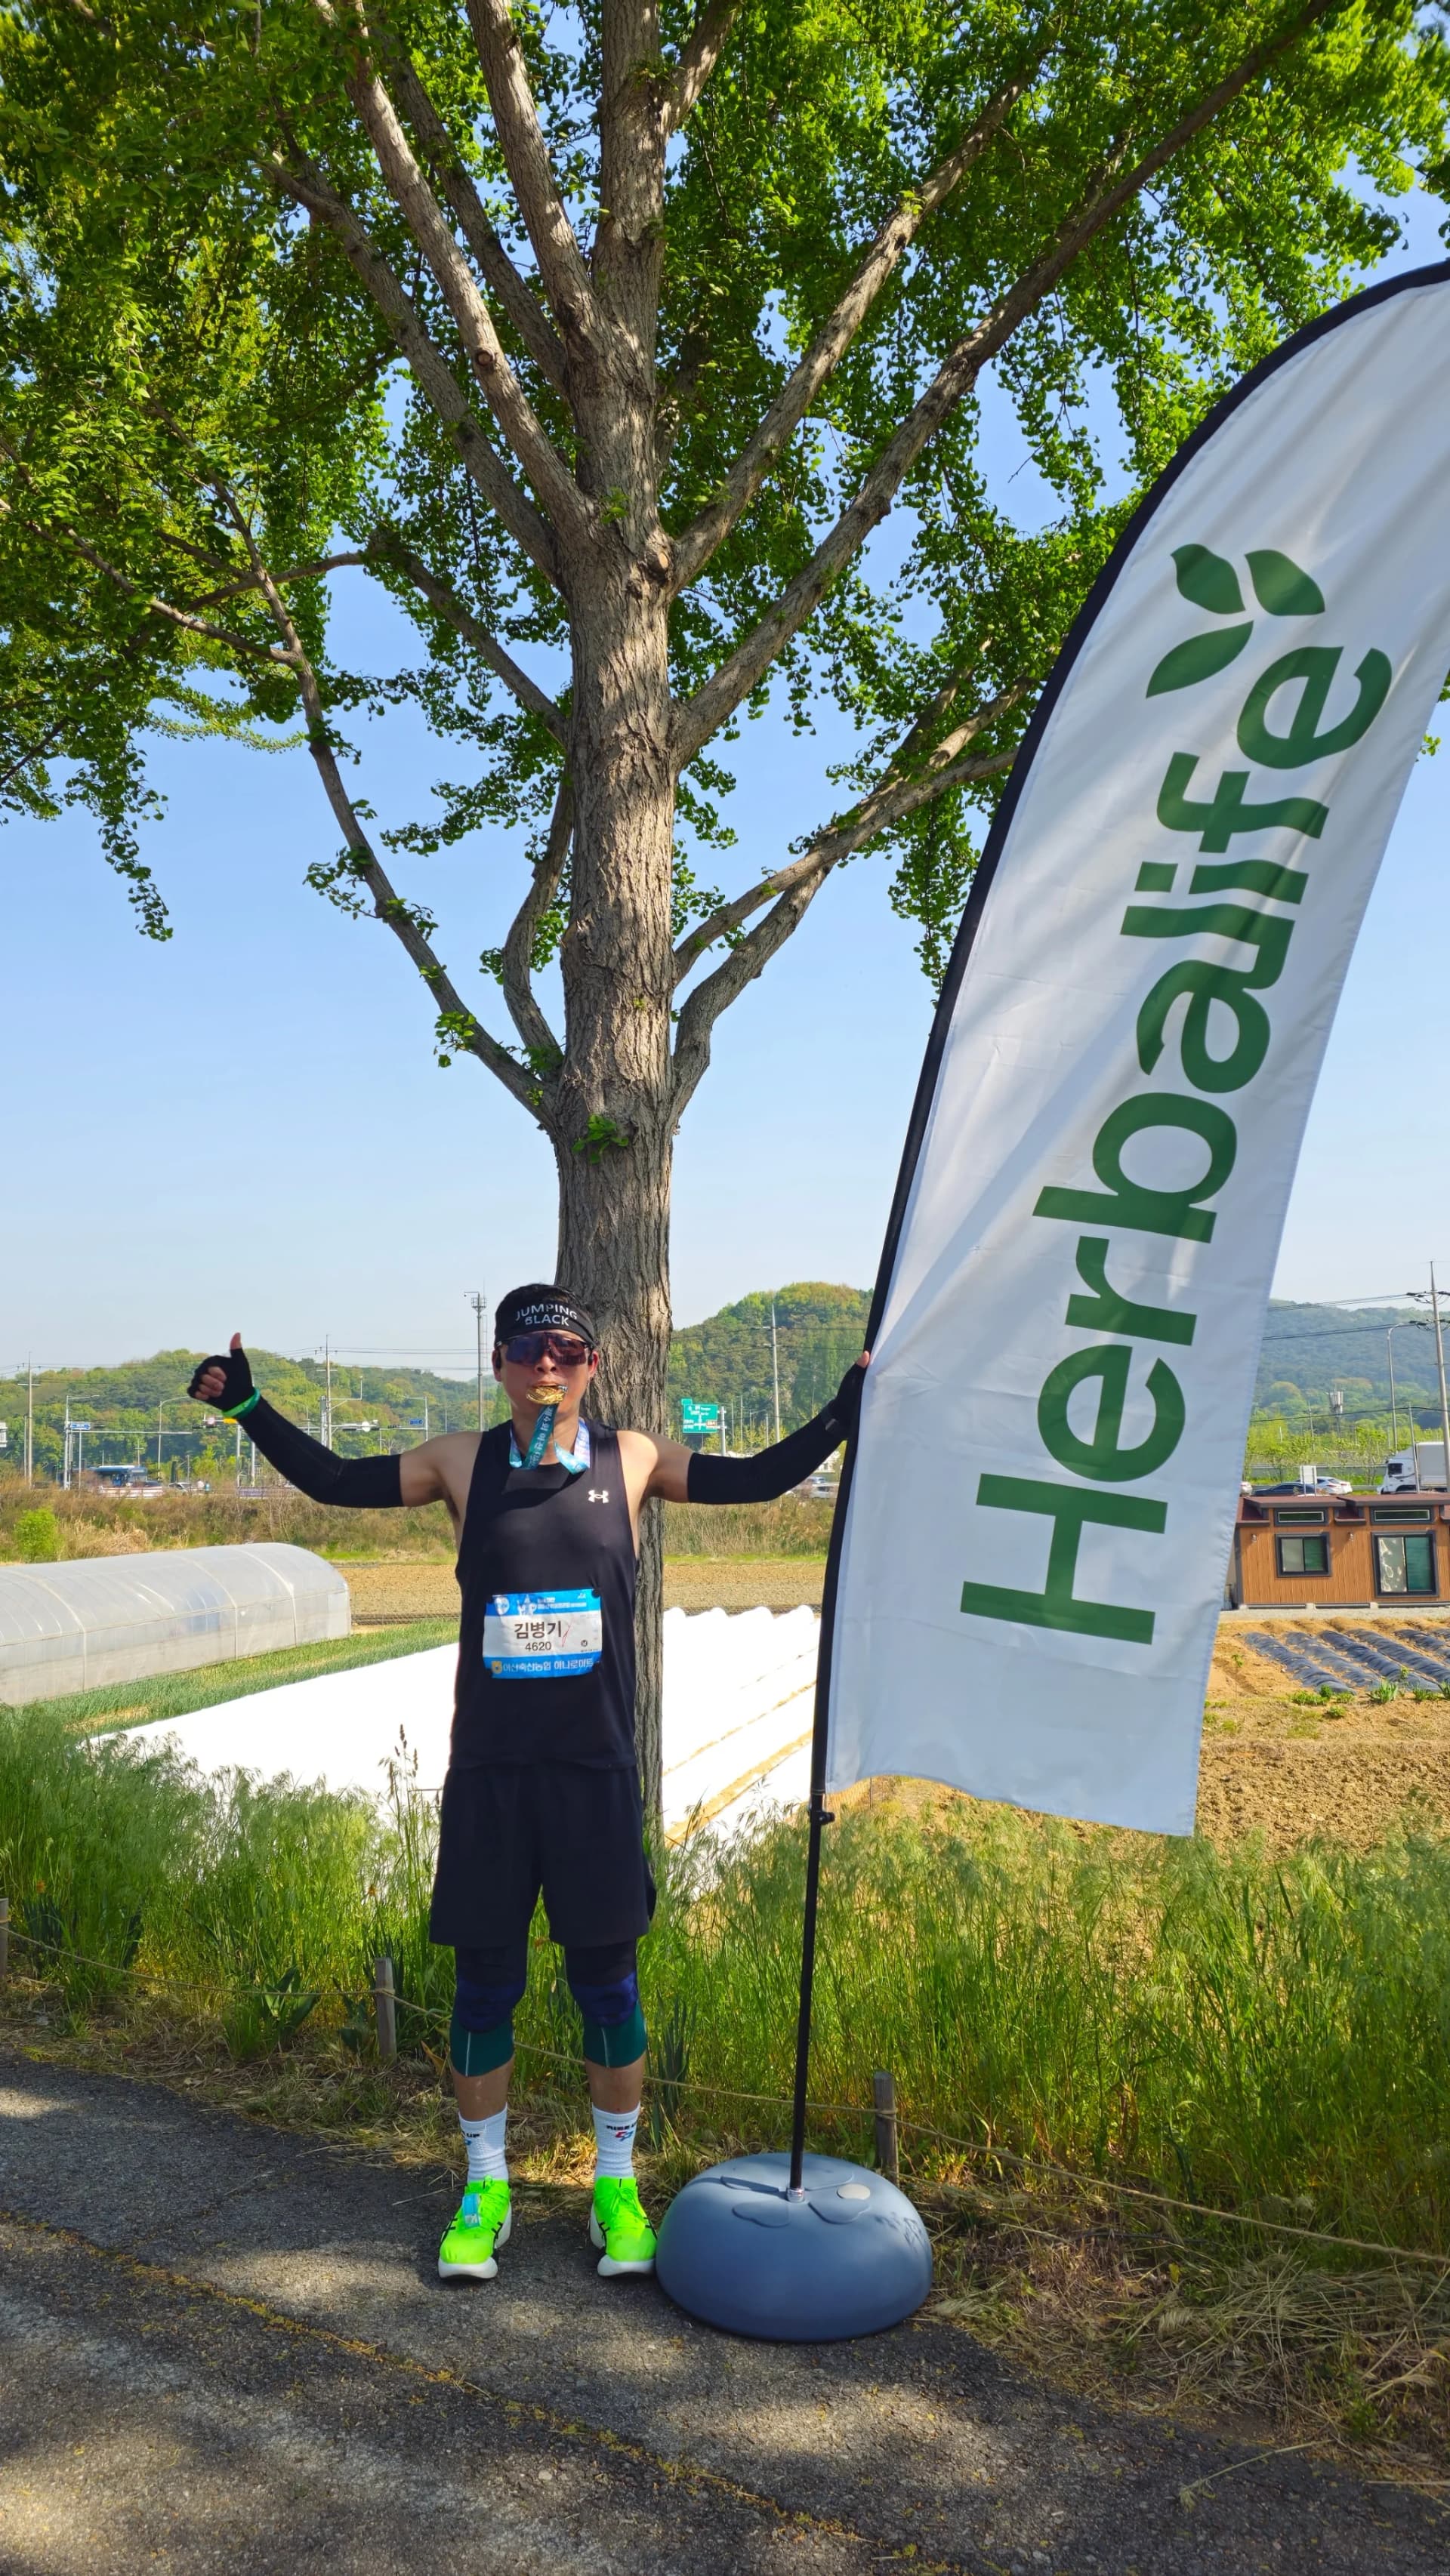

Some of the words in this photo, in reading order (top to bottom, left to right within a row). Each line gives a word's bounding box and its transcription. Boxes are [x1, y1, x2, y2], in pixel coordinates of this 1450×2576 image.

[960, 646, 1392, 1644] Herbalife
[515, 1304, 577, 1321] JUMPING
[525, 1314, 569, 1327] BLACK
[514, 1621, 562, 1639] 김병기
[525, 1641, 552, 1651] 4620
